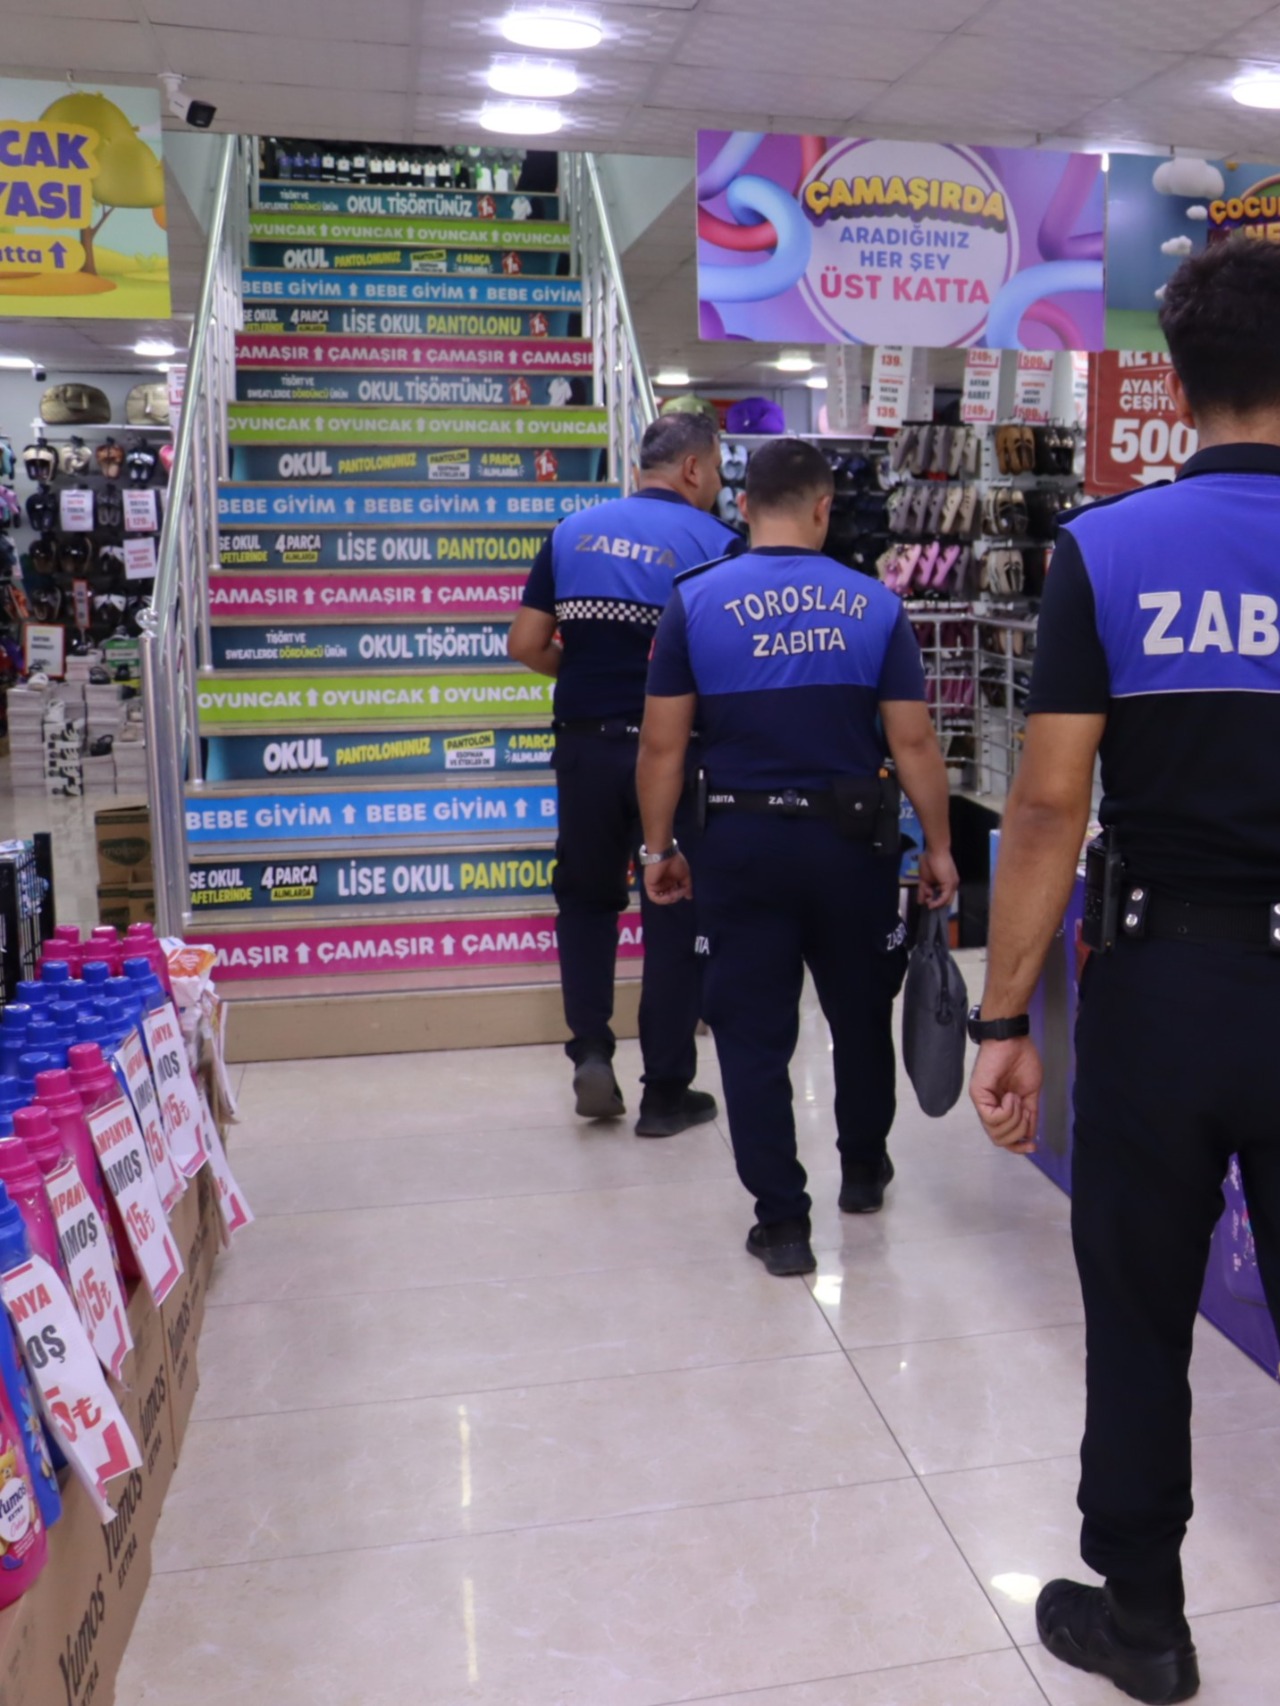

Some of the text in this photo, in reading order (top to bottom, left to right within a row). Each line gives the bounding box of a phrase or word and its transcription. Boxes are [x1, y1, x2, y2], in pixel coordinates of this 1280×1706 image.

[0, 130, 89, 169] CAK
[347, 196, 386, 214] OKUL
[803, 176, 1007, 224] ÇAMAŞIRDA
[331, 226, 403, 239] OYUNCAK
[418, 228, 488, 243] OYUNCAK
[502, 232, 570, 245] OYUNCAK
[840, 225, 970, 249] ARADIĞINIZ
[283, 248, 329, 269] OKUL
[860, 251, 950, 272] HER ŞEY
[242, 279, 342, 296] BEBE GİYİM
[365, 281, 464, 300] BEBE GİYİM
[487, 286, 582, 303] BEBE GİYİM
[820, 266, 990, 304] ÜST KATTA
[301, 310, 329, 324] PARÇA
[342, 308, 521, 336] LİSE OKUL PANTOLONU
[328, 347, 407, 364] ÇAMAŞIR
[426, 348, 504, 365] ÇAMAŞIR
[358, 377, 503, 403] OKUL TİŞÖRTÜNÜZ
[1120, 378, 1168, 395] AYAK
[328, 417, 412, 432] OYUNCAK
[429, 419, 511, 433] OYUNCAK
[528, 421, 608, 434] OYUNCAK
[1110, 418, 1198, 464] 500
[279, 451, 332, 477] OKUL
[218, 495, 336, 514] BEBE GİYİM
[364, 495, 479, 514] BEBE GİYİM
[507, 498, 555, 513] BEBE
[232, 535, 261, 550] OKUL
[275, 534, 321, 552] 4 PARÇA
[337, 532, 378, 562] LİSE
[382, 537, 432, 561] OKUL
[575, 533, 677, 569] ZABITA
[320, 586, 415, 605] ÇAMAŞIR
[724, 585, 867, 627] TOROSLAR
[358, 628, 508, 660] OKUL TİŞÖRTÜN
[752, 627, 846, 658] ZABITA
[225, 649, 278, 660] SWEATLERDE
[199, 691, 302, 709] OYUNCAK
[322, 689, 424, 706] OYUNCAK
[444, 686, 542, 703] OYUNCAK
[447, 734, 491, 750] PANTOLON
[509, 735, 518, 748] 4
[263, 737, 431, 772] OKUL PANTOLONUNUZ
[185, 803, 331, 830] BEBE GİYİM
[366, 797, 507, 823] BEBE GİYİM
[189, 868, 244, 889] SE OKUL
[261, 865, 318, 889] 4 PARÇA
[338, 859, 558, 897] LİSE OKUL PANTOL
[191, 887, 253, 904] AFETLERİNDE
[317, 937, 434, 963] ÇAMAŞIR
[462, 931, 558, 955] ÇAMAŞI
[215, 945, 289, 968] MAŞIR
[105, 1149, 143, 1197] UMOŞ
